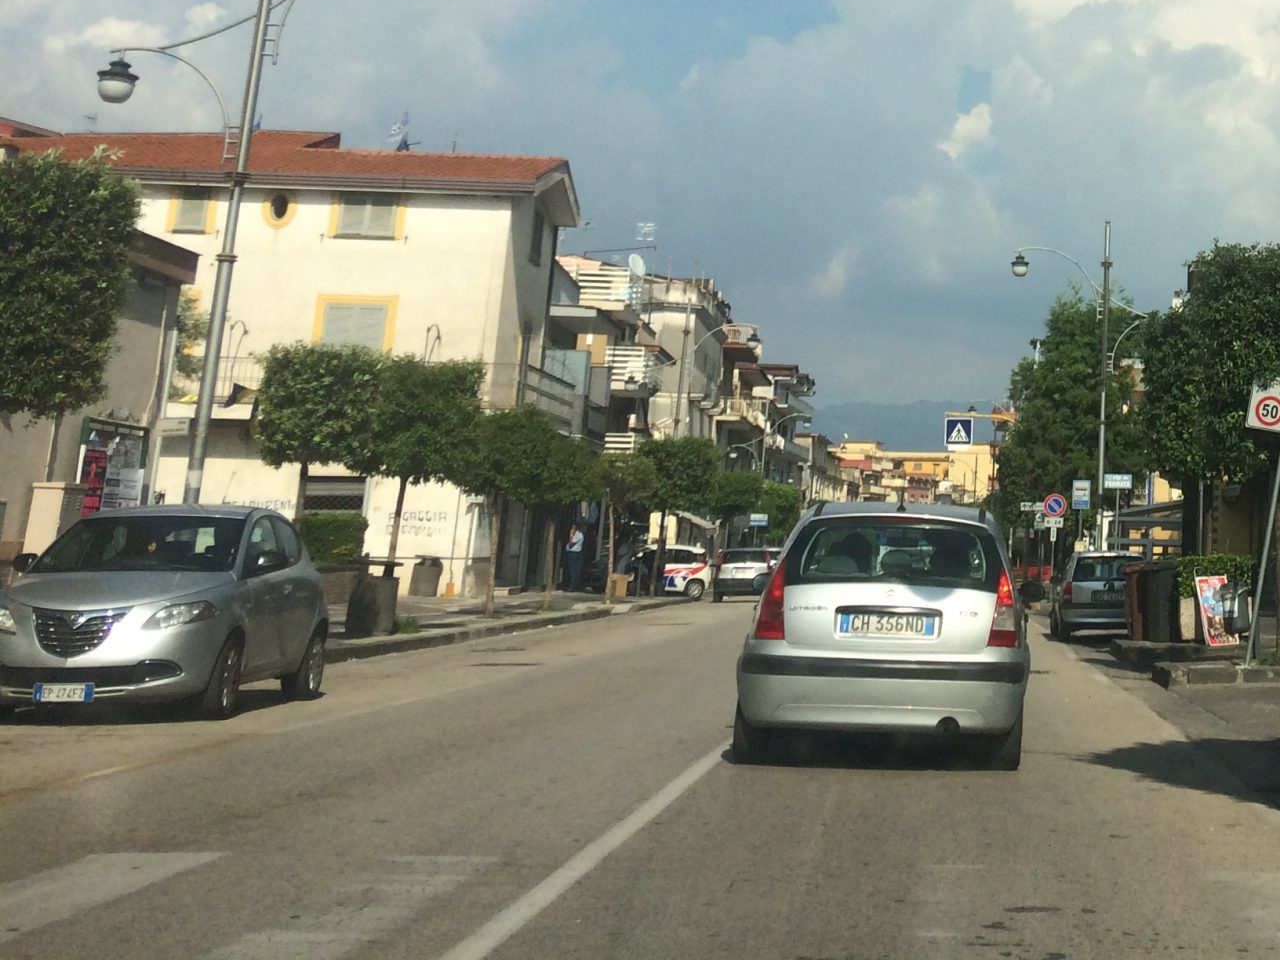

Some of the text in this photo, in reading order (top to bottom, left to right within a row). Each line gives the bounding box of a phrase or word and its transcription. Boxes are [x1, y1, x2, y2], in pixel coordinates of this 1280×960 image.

[1261, 403, 1278, 419] 50
[851, 615, 870, 632] CH
[875, 615, 924, 633] 356ND
